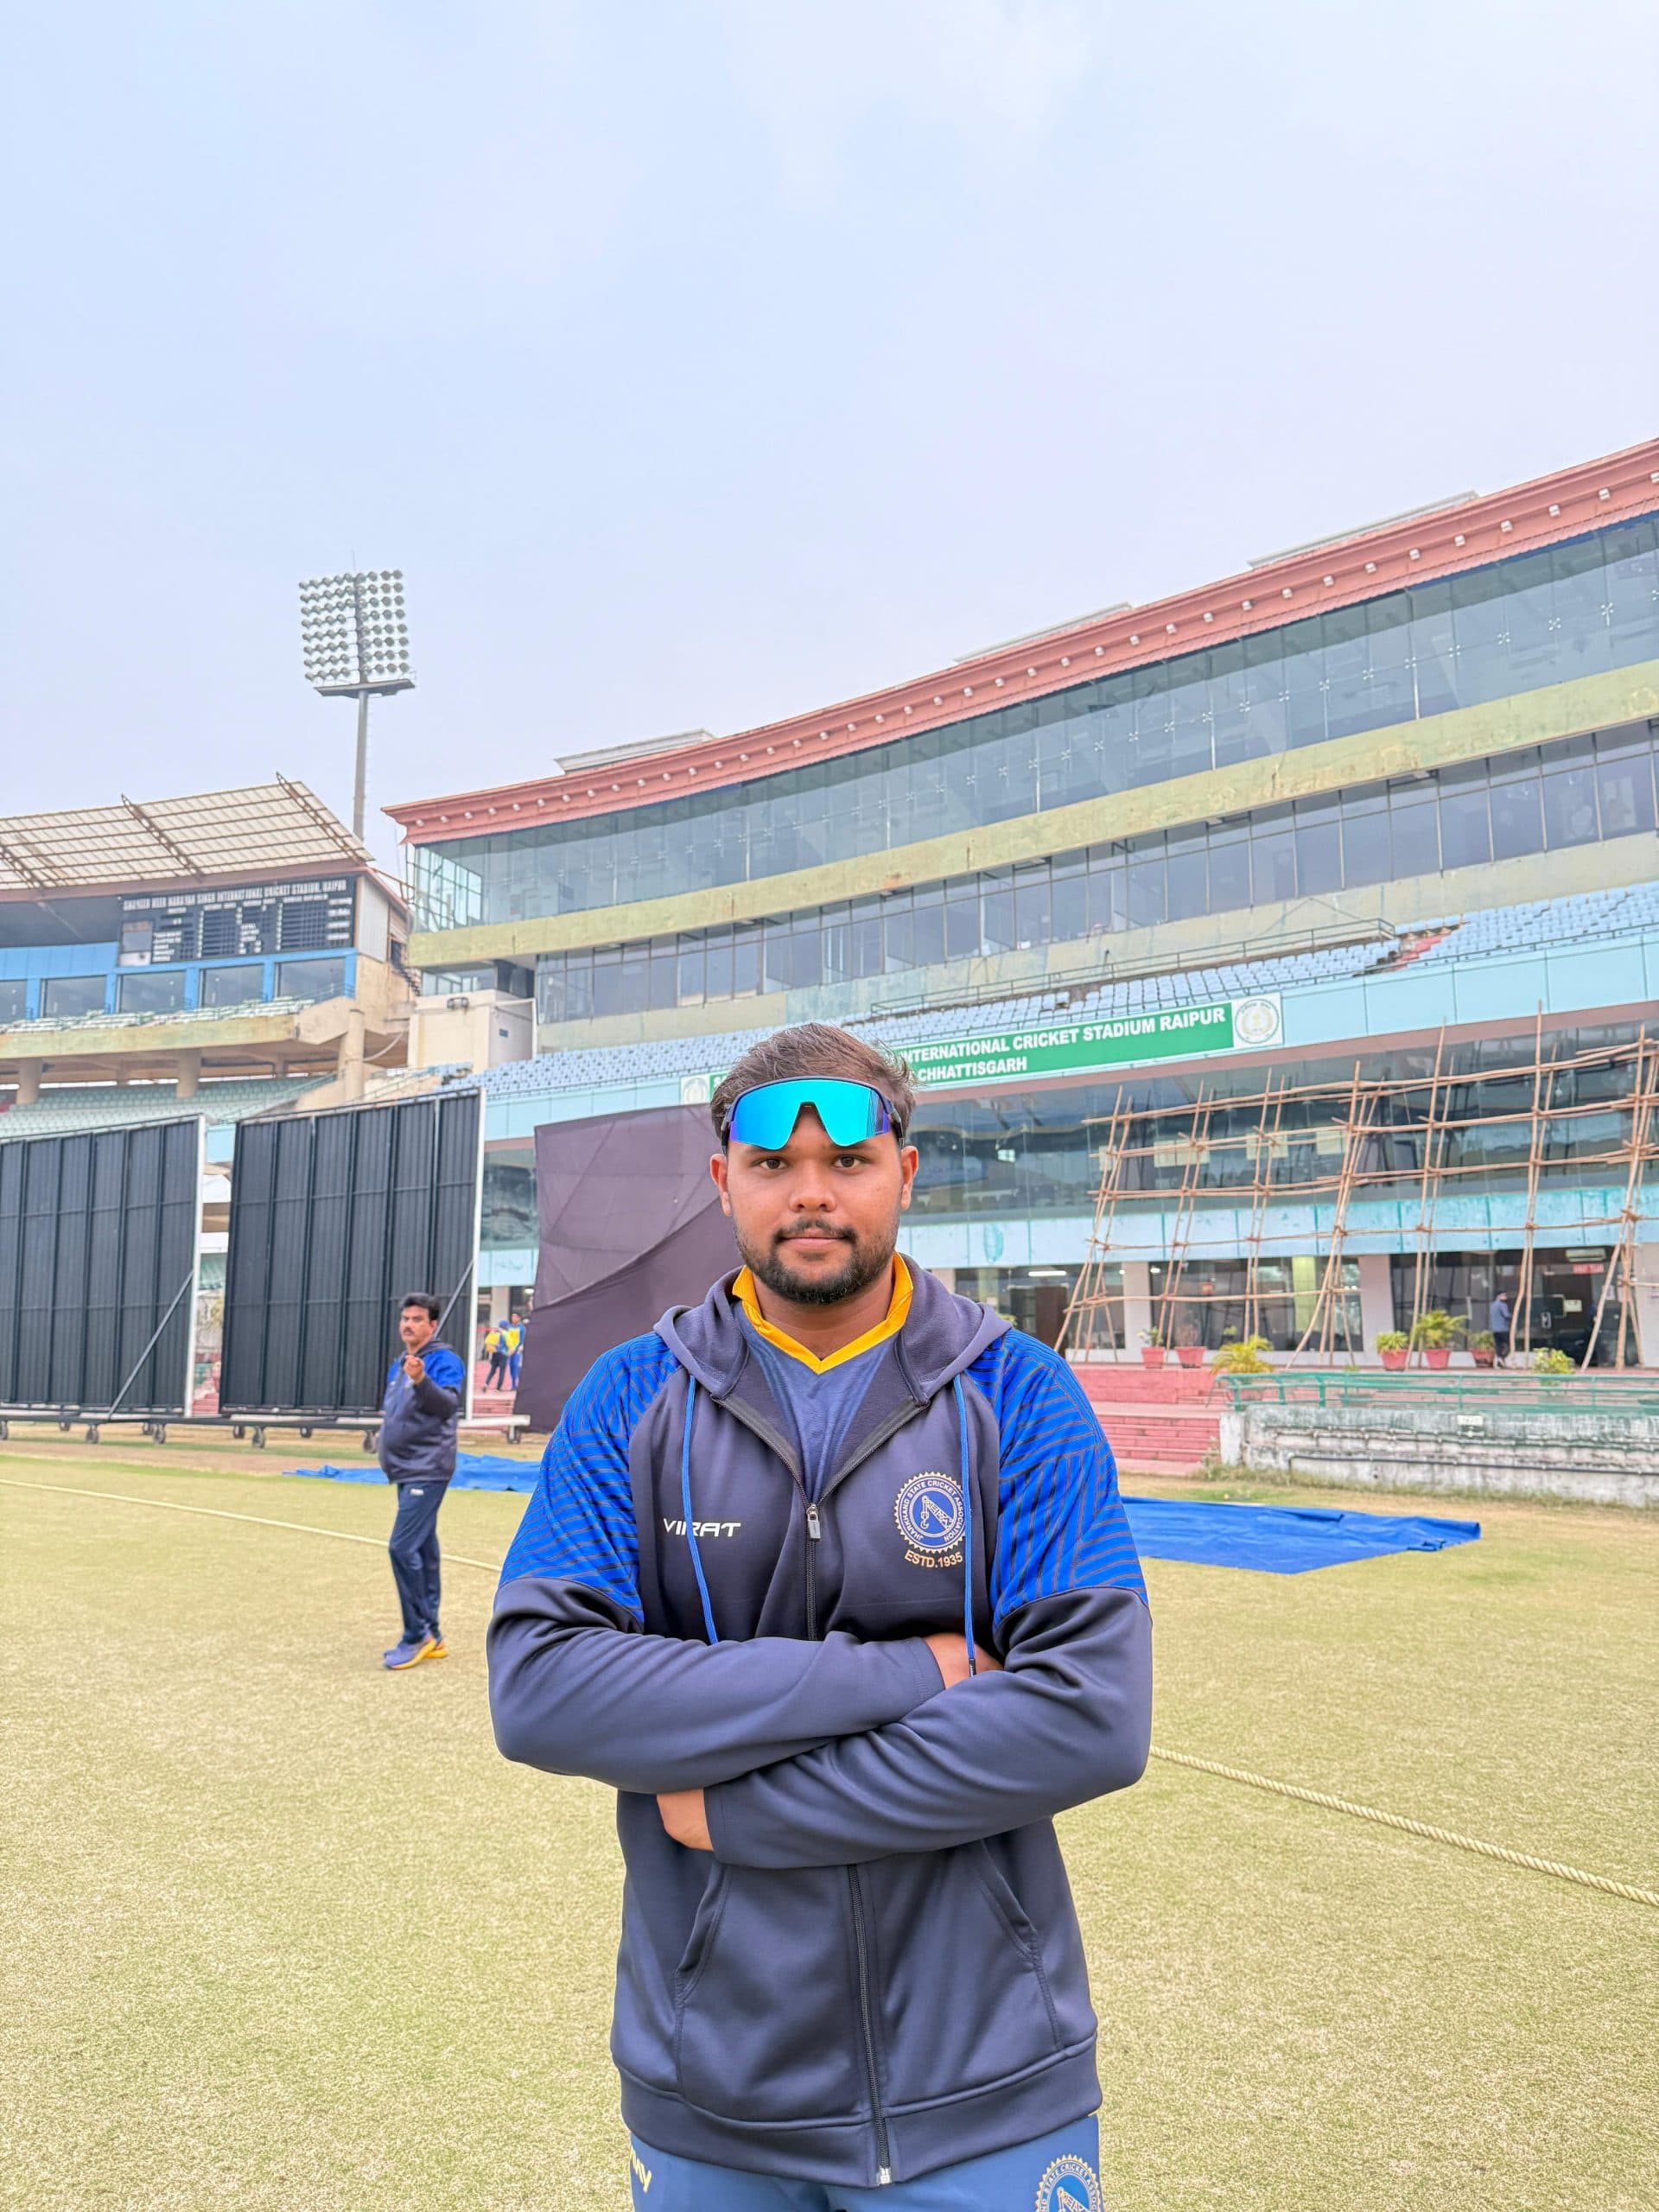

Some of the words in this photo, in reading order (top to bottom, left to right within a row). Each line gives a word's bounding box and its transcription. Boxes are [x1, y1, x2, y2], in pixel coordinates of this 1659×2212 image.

[1013, 1028, 1079, 1051] CRICKET
[1083, 1018, 1155, 1041] STADIUM
[1160, 1007, 1226, 1031] RAIPUR
[918, 1056, 1027, 1082] CHHATTISGARH
[907, 1482, 926, 1498] STATE
[927, 1480, 957, 1496] CRICKET
[663, 1517, 741, 1537] VIRAT
[902, 1499, 924, 1541] JHARKHAND
[944, 1497, 963, 1542] ASSOCIATION
[905, 1549, 963, 1568] ESTD.1935
[1060, 2164, 1088, 2178] CRICKET
